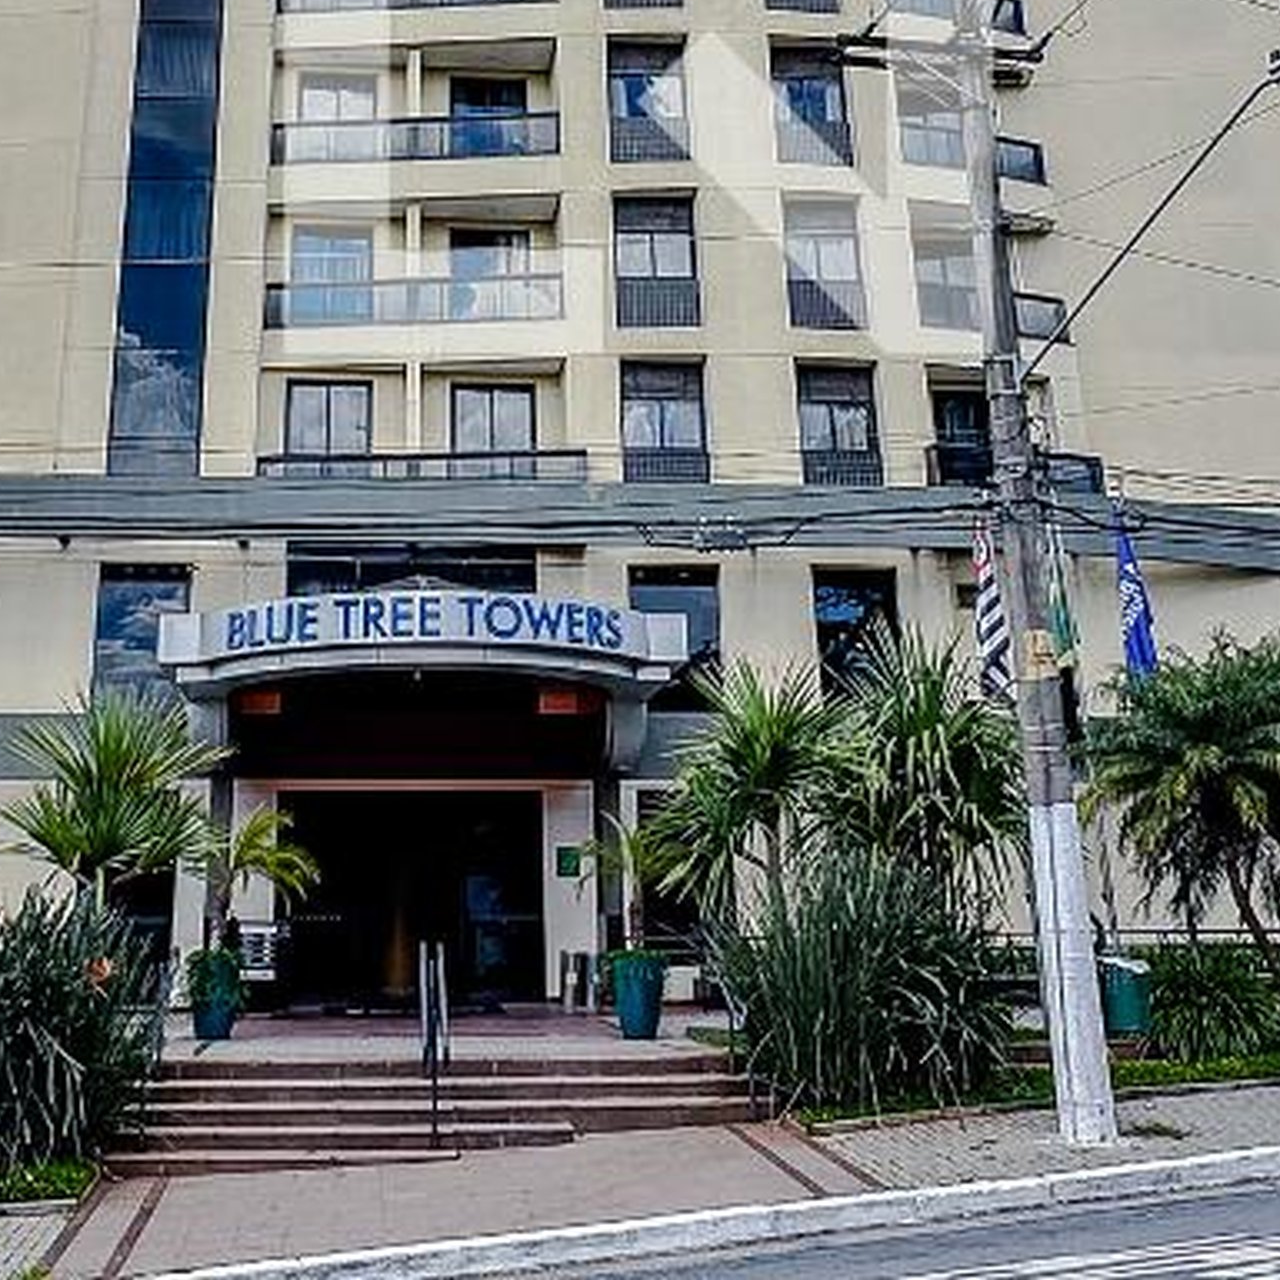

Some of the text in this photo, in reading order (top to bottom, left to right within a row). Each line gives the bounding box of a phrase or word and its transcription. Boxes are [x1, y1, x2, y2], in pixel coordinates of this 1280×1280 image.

[227, 596, 623, 650] BLUE TREE TOWERS
